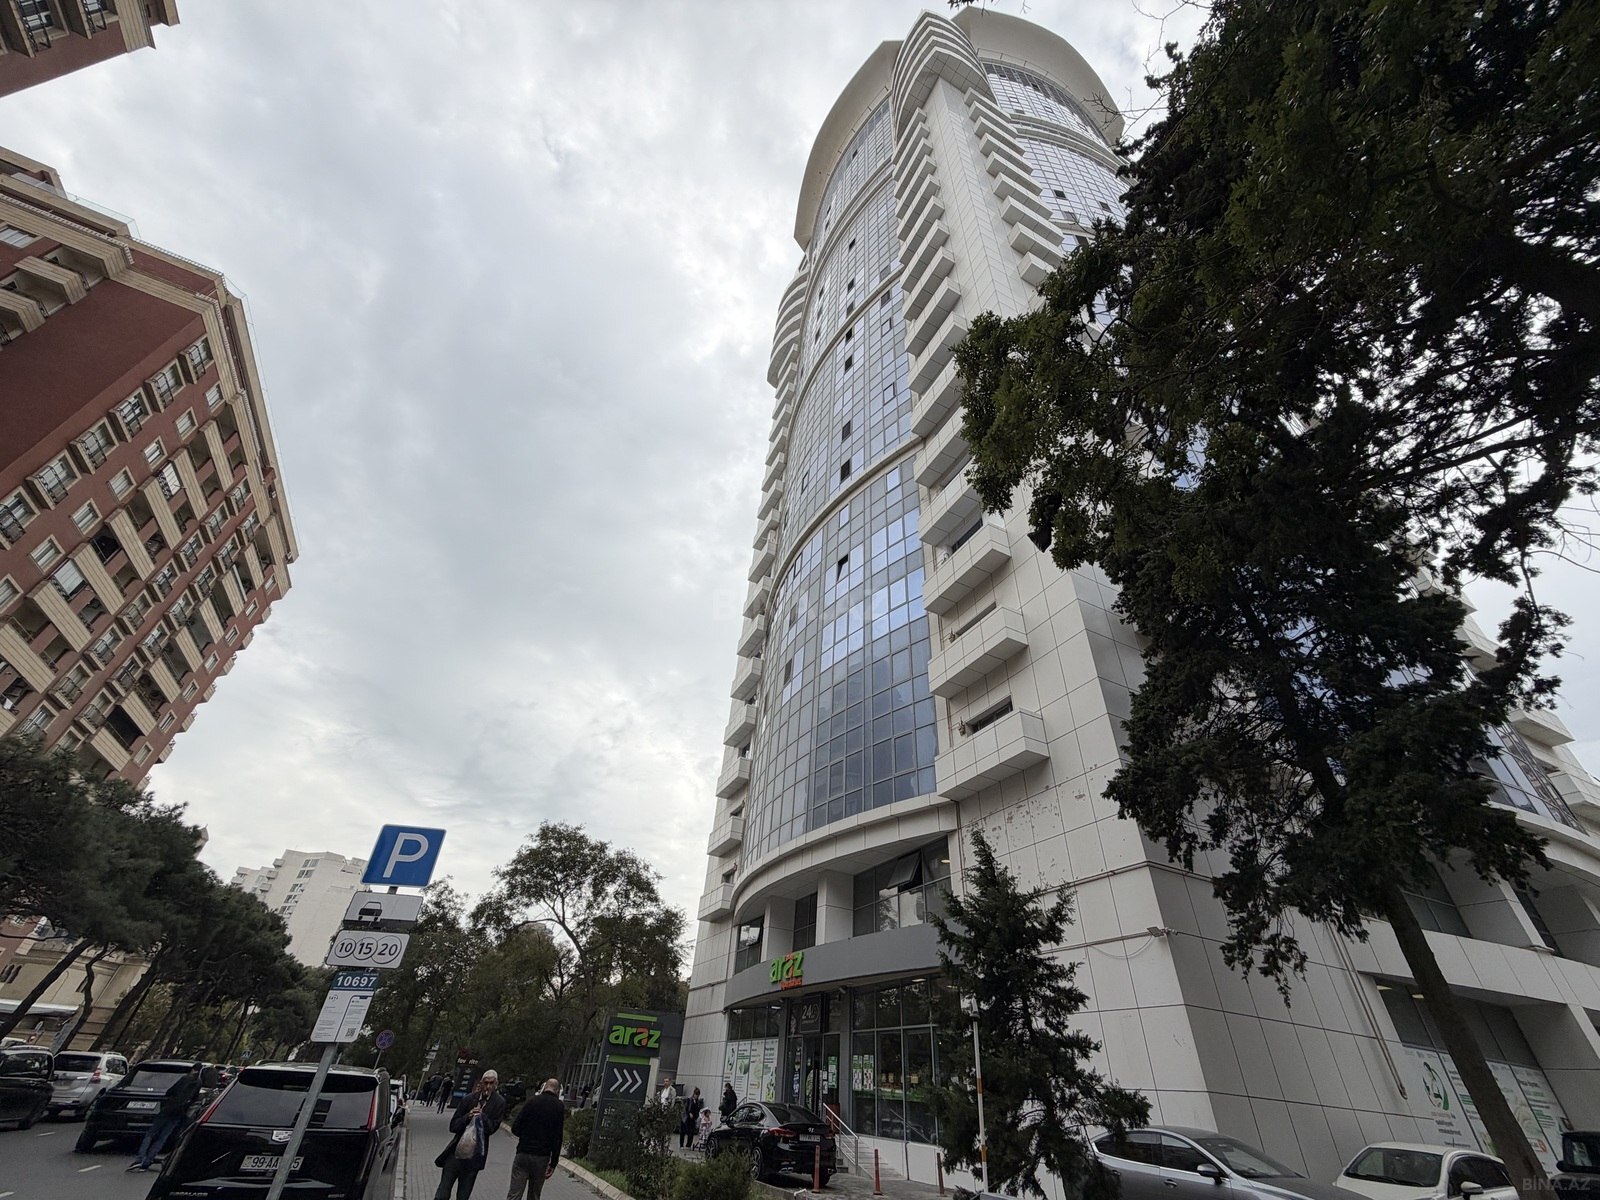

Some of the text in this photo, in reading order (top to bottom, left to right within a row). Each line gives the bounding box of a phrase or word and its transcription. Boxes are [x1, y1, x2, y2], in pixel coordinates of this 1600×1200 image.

[383, 832, 429, 878] P
[338, 942, 398, 956] 10 15 20
[770, 951, 804, 983] araz
[337, 975, 377, 987] 10697
[609, 1025, 661, 1049] araz
